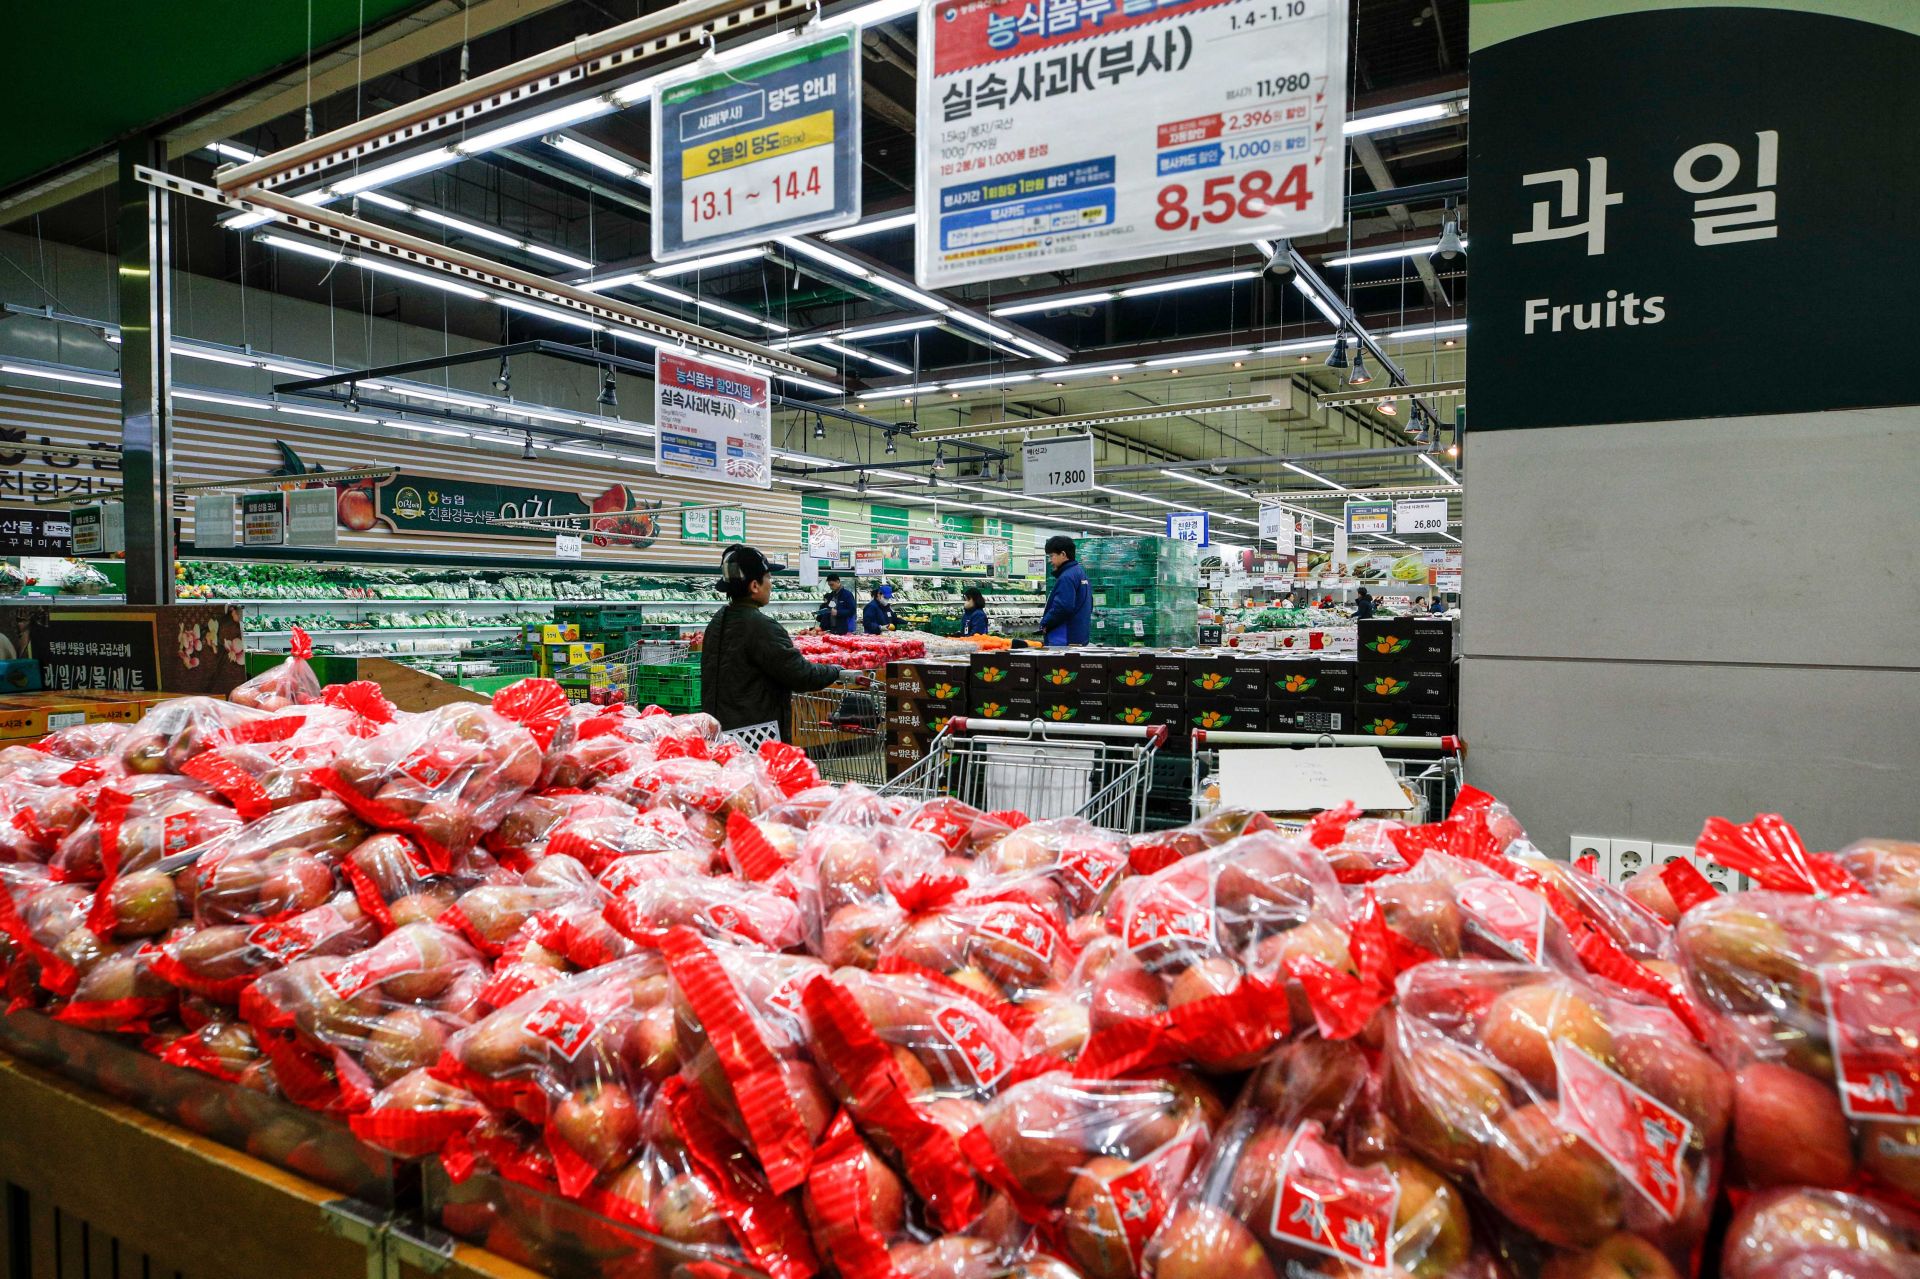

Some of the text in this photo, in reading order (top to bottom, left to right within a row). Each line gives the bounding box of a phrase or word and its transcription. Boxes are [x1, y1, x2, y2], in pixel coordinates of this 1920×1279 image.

[942, 26, 1192, 122] 실속사과(부사)
[768, 73, 837, 112] 당도 안내
[1257, 72, 1310, 97] 11,980
[697, 105, 743, 130] 사과(부사)
[1286, 106, 1306, 119] 할인
[1286, 137, 1306, 150] 할인
[707, 141, 749, 168] 오늘의
[1160, 151, 1219, 172] 행사카드 할인
[691, 187, 733, 223] 13.1
[772, 165, 822, 204] 14.4
[1155, 164, 1314, 231] 8,584
[1524, 289, 1666, 335] Fruits
[676, 367, 752, 400] 농식품부 할인지원
[661, 389, 736, 420] 실속사과(부사)
[1026, 447, 1047, 455] 배(신고)
[1048, 469, 1086, 486] 17,800
[428, 506, 496, 526] 친환경농산물
[689, 511, 706, 524] 유기농
[724, 514, 741, 526] 무농약
[1178, 520, 1198, 531] 친환경
[1414, 519, 1442, 530] 26,800
[49, 641, 67, 655] 특별한
[67, 643, 85, 655] 선물을
[100, 644, 132, 659] 고급스럽게
[564, 688, 588, 699] 품진열
[107, 711, 123, 719] 사과
